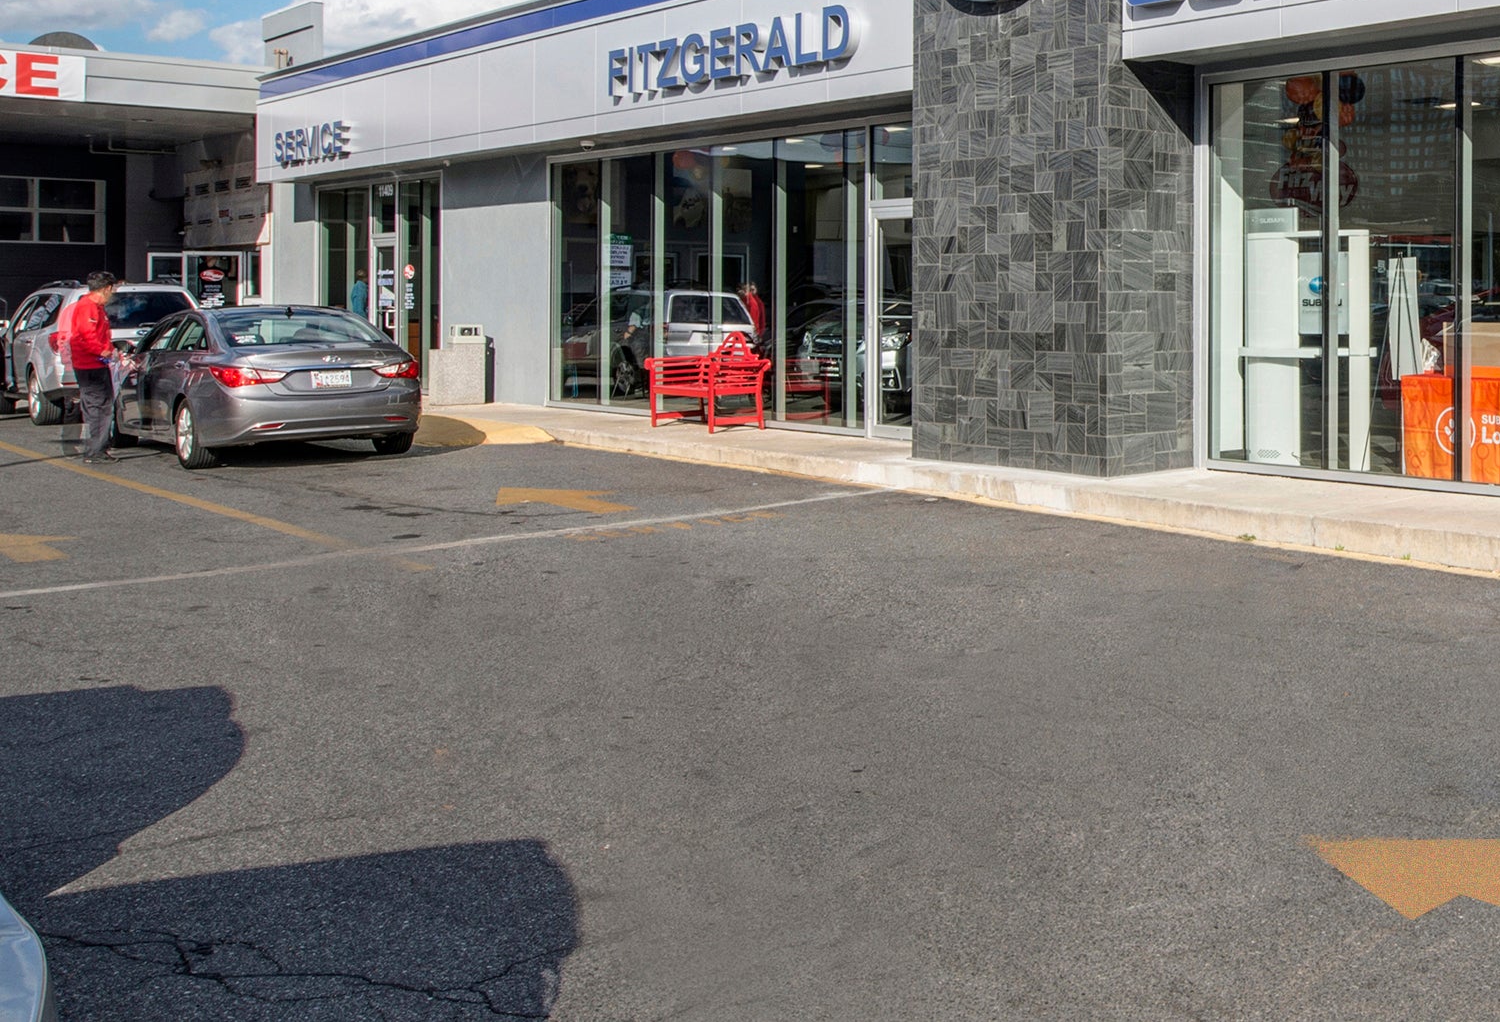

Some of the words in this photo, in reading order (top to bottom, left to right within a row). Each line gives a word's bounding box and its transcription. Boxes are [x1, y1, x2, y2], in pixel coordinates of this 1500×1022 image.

[607, 4, 850, 97] FITZGERALD
[274, 120, 346, 163] SERVICE
[1309, 180, 1355, 207] WY
[1302, 298, 1343, 307] SUBU
